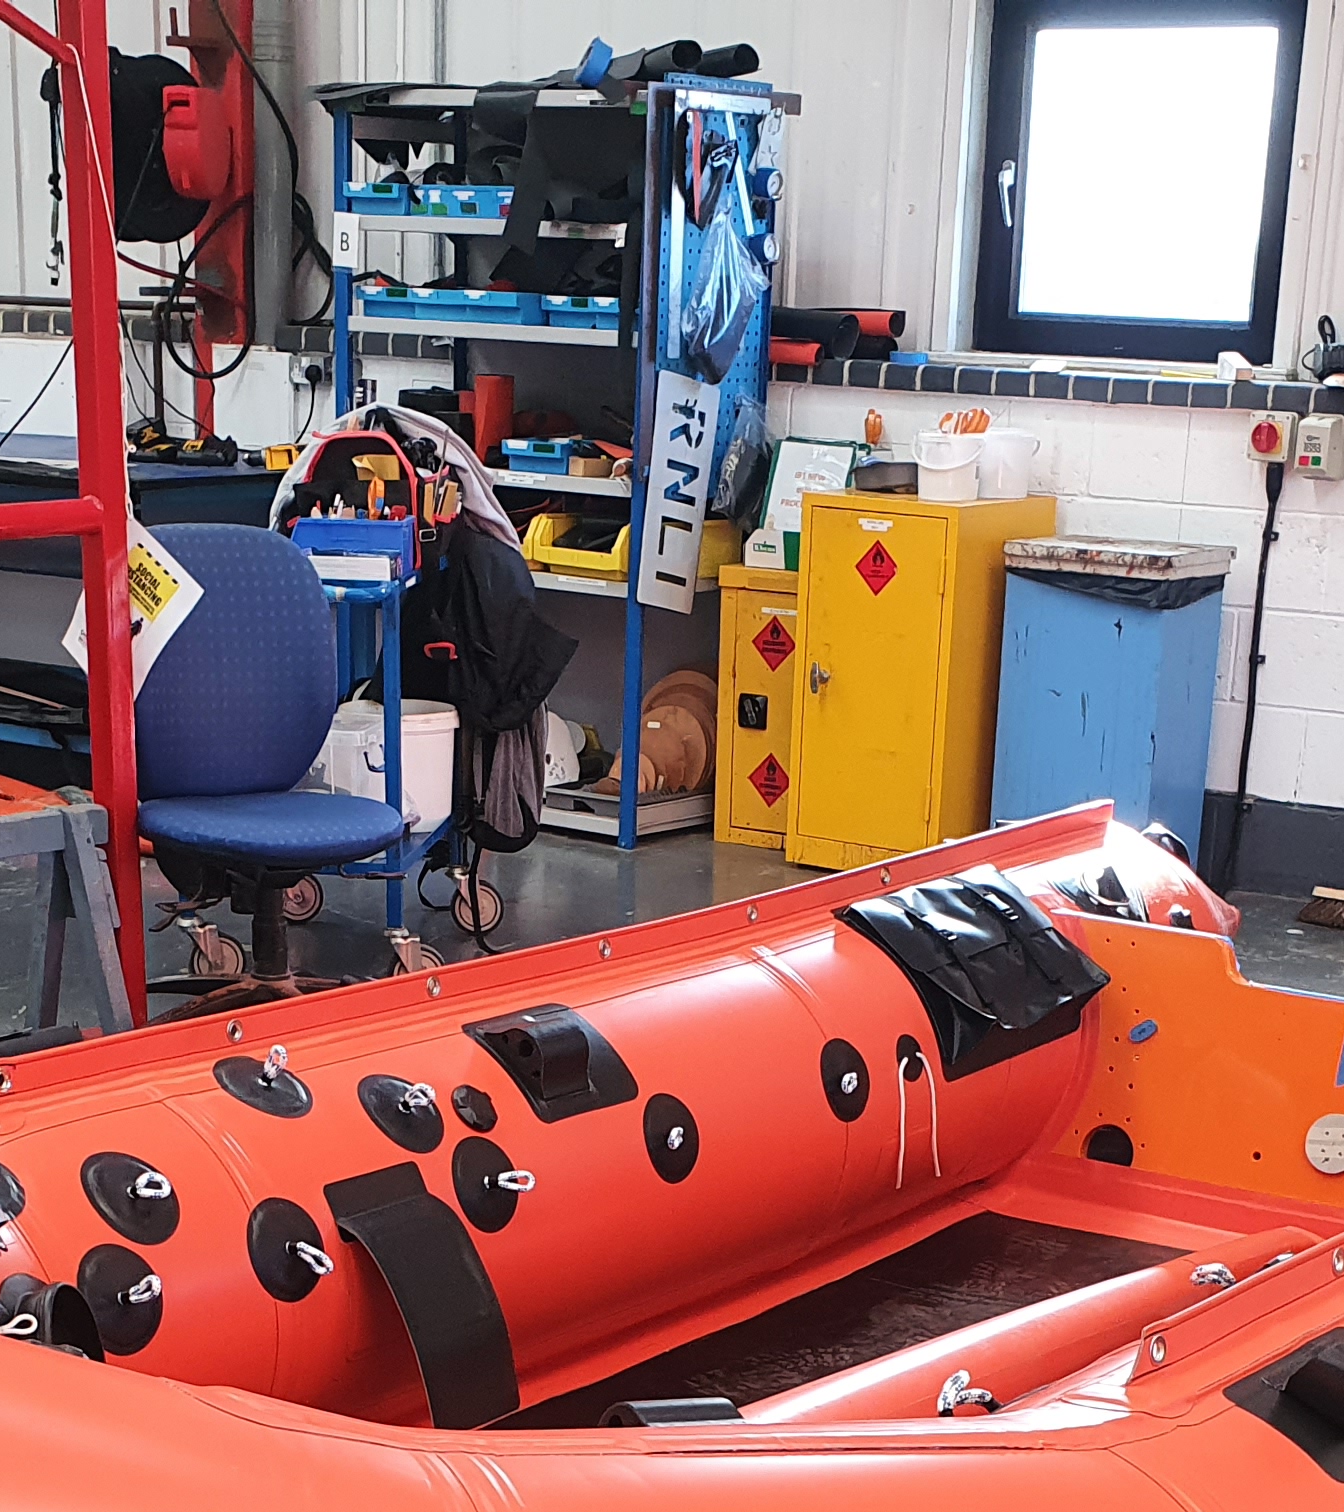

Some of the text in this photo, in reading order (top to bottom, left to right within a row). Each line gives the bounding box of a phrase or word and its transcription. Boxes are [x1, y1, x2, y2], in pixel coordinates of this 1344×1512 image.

[340, 231, 350, 252] B
[656, 398, 707, 587] RNLI
[127, 563, 163, 608] ISTANCING
[136, 562, 161, 591] SOCIAL
